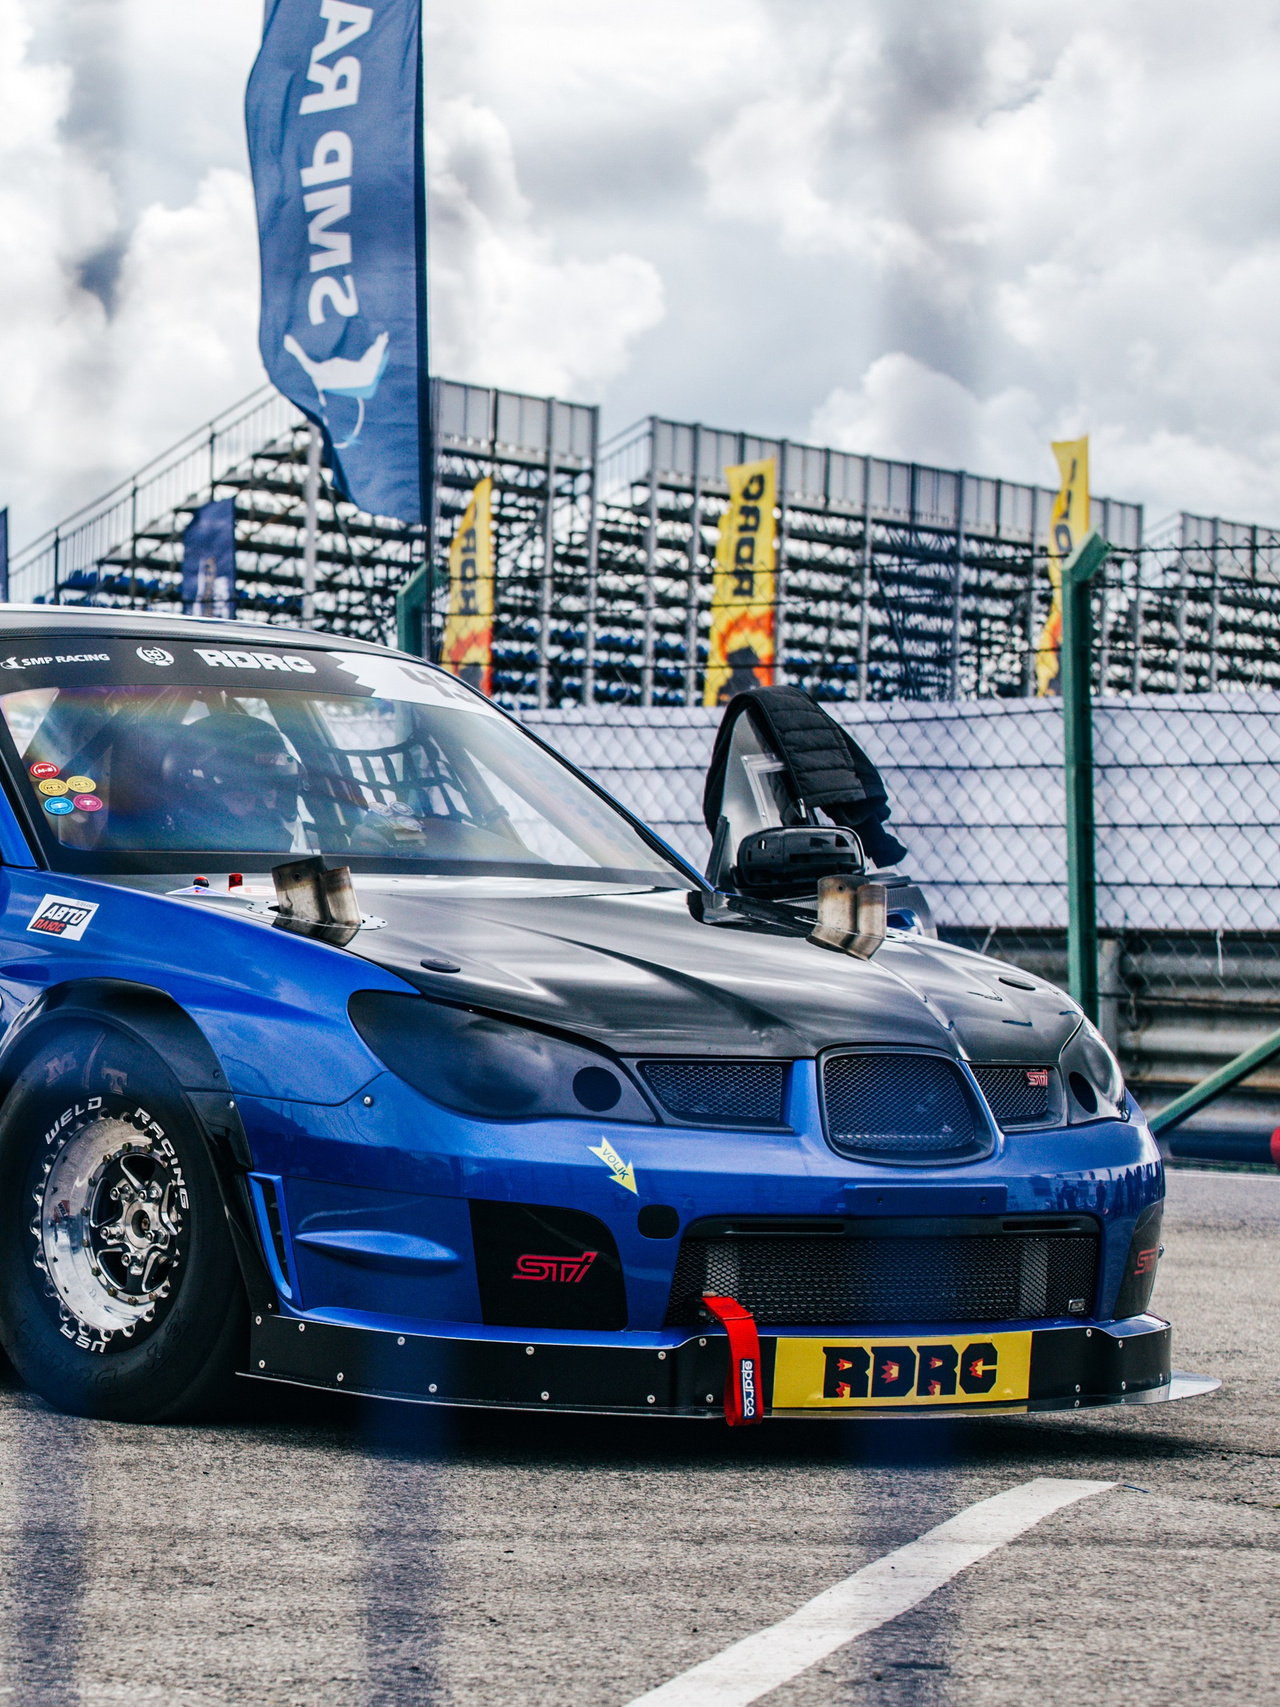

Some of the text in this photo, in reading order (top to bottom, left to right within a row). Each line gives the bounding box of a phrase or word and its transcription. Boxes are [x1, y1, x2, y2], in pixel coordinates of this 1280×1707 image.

[21, 653, 111, 666] SMP RACING
[193, 649, 317, 674] RDRC
[33, 918, 65, 933] ПЛЮС
[42, 905, 87, 925] АВТО
[44, 1096, 190, 1210] WELD RACING
[602, 1148, 630, 1180] VOLIK
[59, 1323, 107, 1354] USA
[822, 1342, 999, 1399] RDRC
[741, 1360, 755, 1418] sparco
